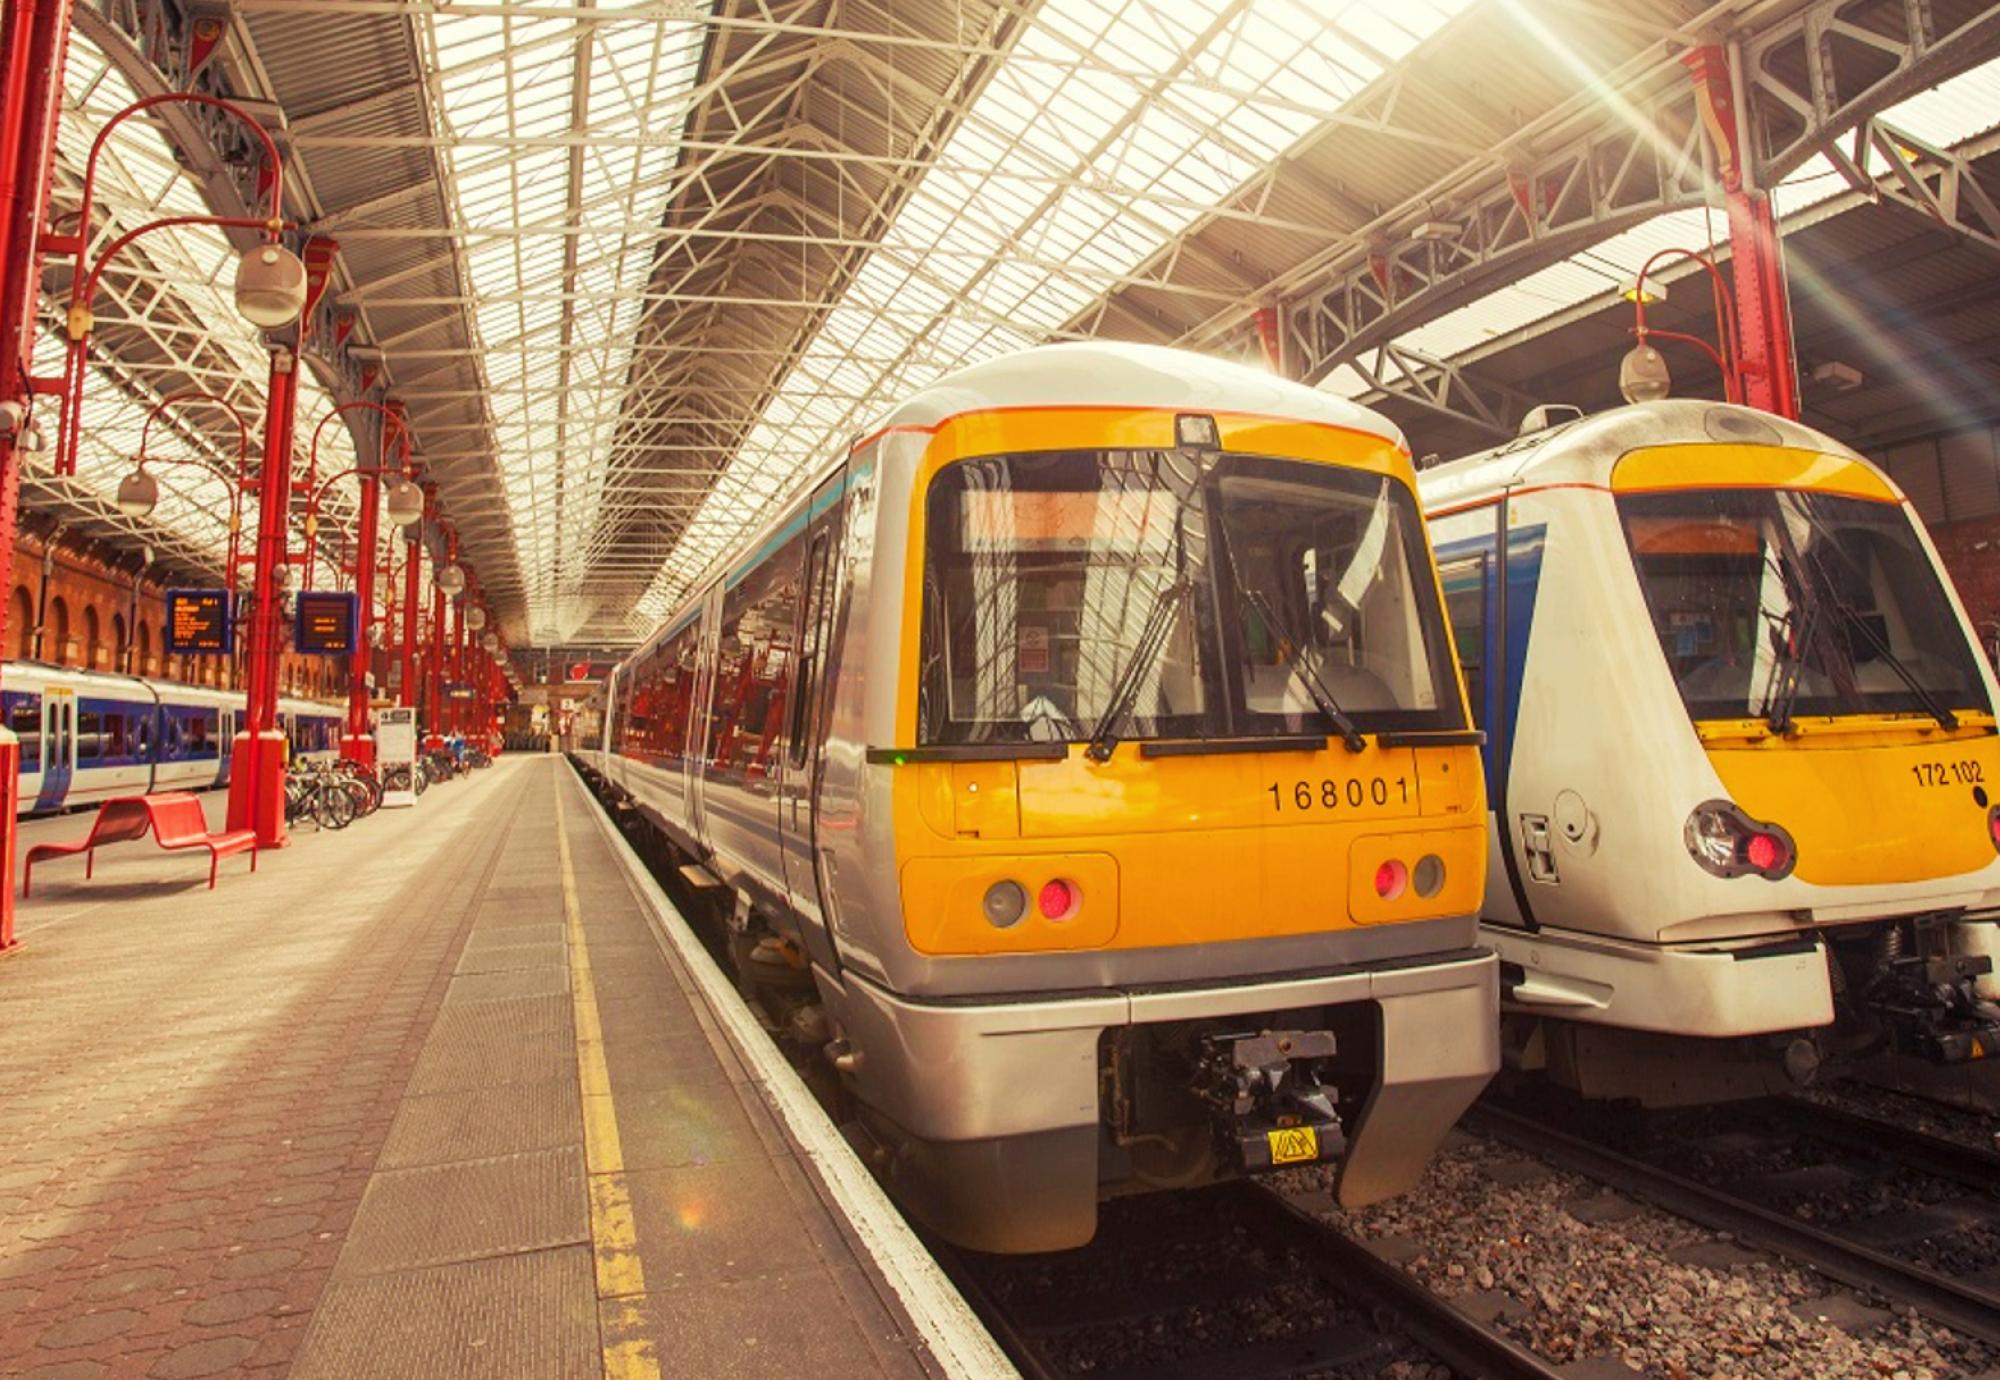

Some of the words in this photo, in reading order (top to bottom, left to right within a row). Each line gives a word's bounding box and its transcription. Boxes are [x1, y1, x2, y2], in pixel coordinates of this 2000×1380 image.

[1911, 763, 1950, 786] 172
[1951, 760, 1985, 783] 102
[1268, 777, 1407, 811] 168001
